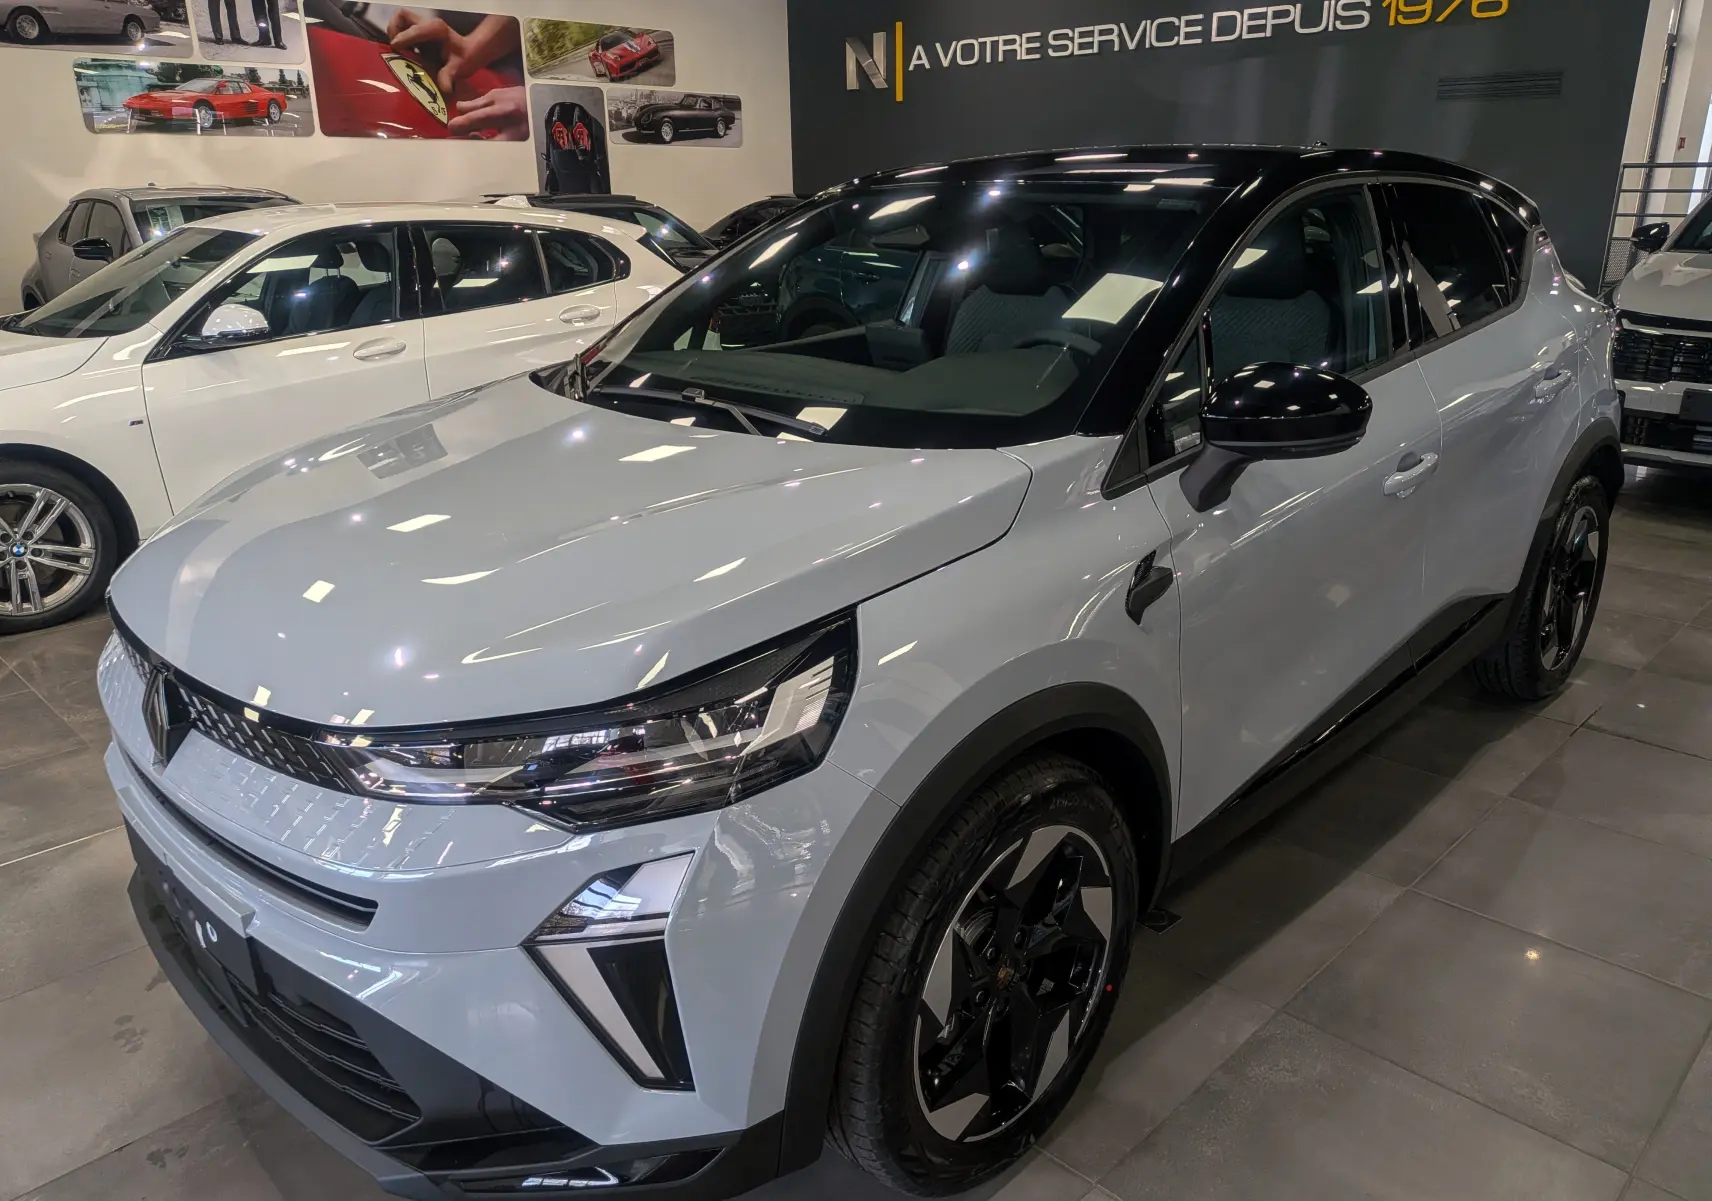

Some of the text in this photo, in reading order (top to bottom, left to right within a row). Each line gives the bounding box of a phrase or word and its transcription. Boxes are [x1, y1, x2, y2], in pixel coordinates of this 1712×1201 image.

[908, 44, 931, 71] A
[935, 31, 1042, 68] VOTRE
[1047, 13, 1205, 57] SERVICE
[1211, 0, 1371, 43] DEPUIS
